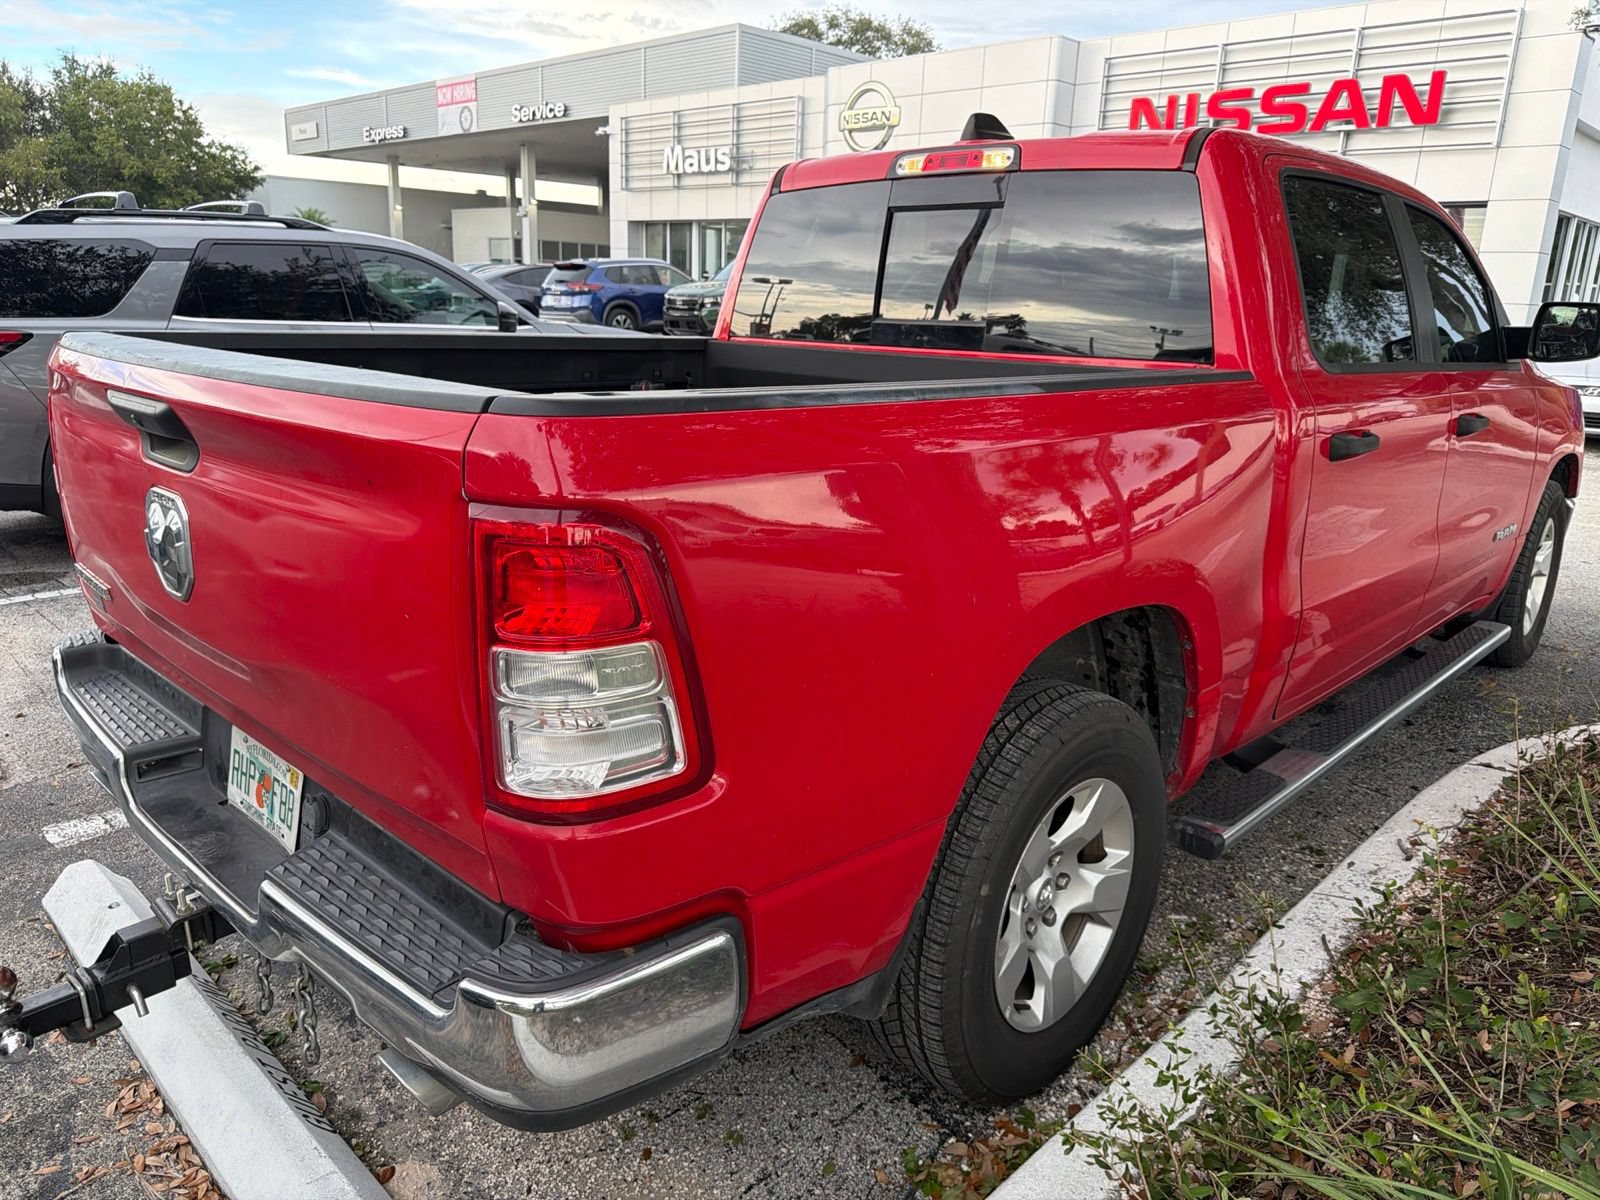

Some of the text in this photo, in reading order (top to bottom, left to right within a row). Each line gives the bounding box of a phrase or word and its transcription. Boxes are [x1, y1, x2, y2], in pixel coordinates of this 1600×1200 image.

[511, 101, 565, 122] Service
[1129, 70, 1447, 135] NISSAN
[843, 110, 892, 126] NISSAN
[363, 125, 404, 143] Express
[662, 145, 731, 174] Maus
[1494, 523, 1517, 541] RAM
[256, 1058, 338, 1134] GUEST
